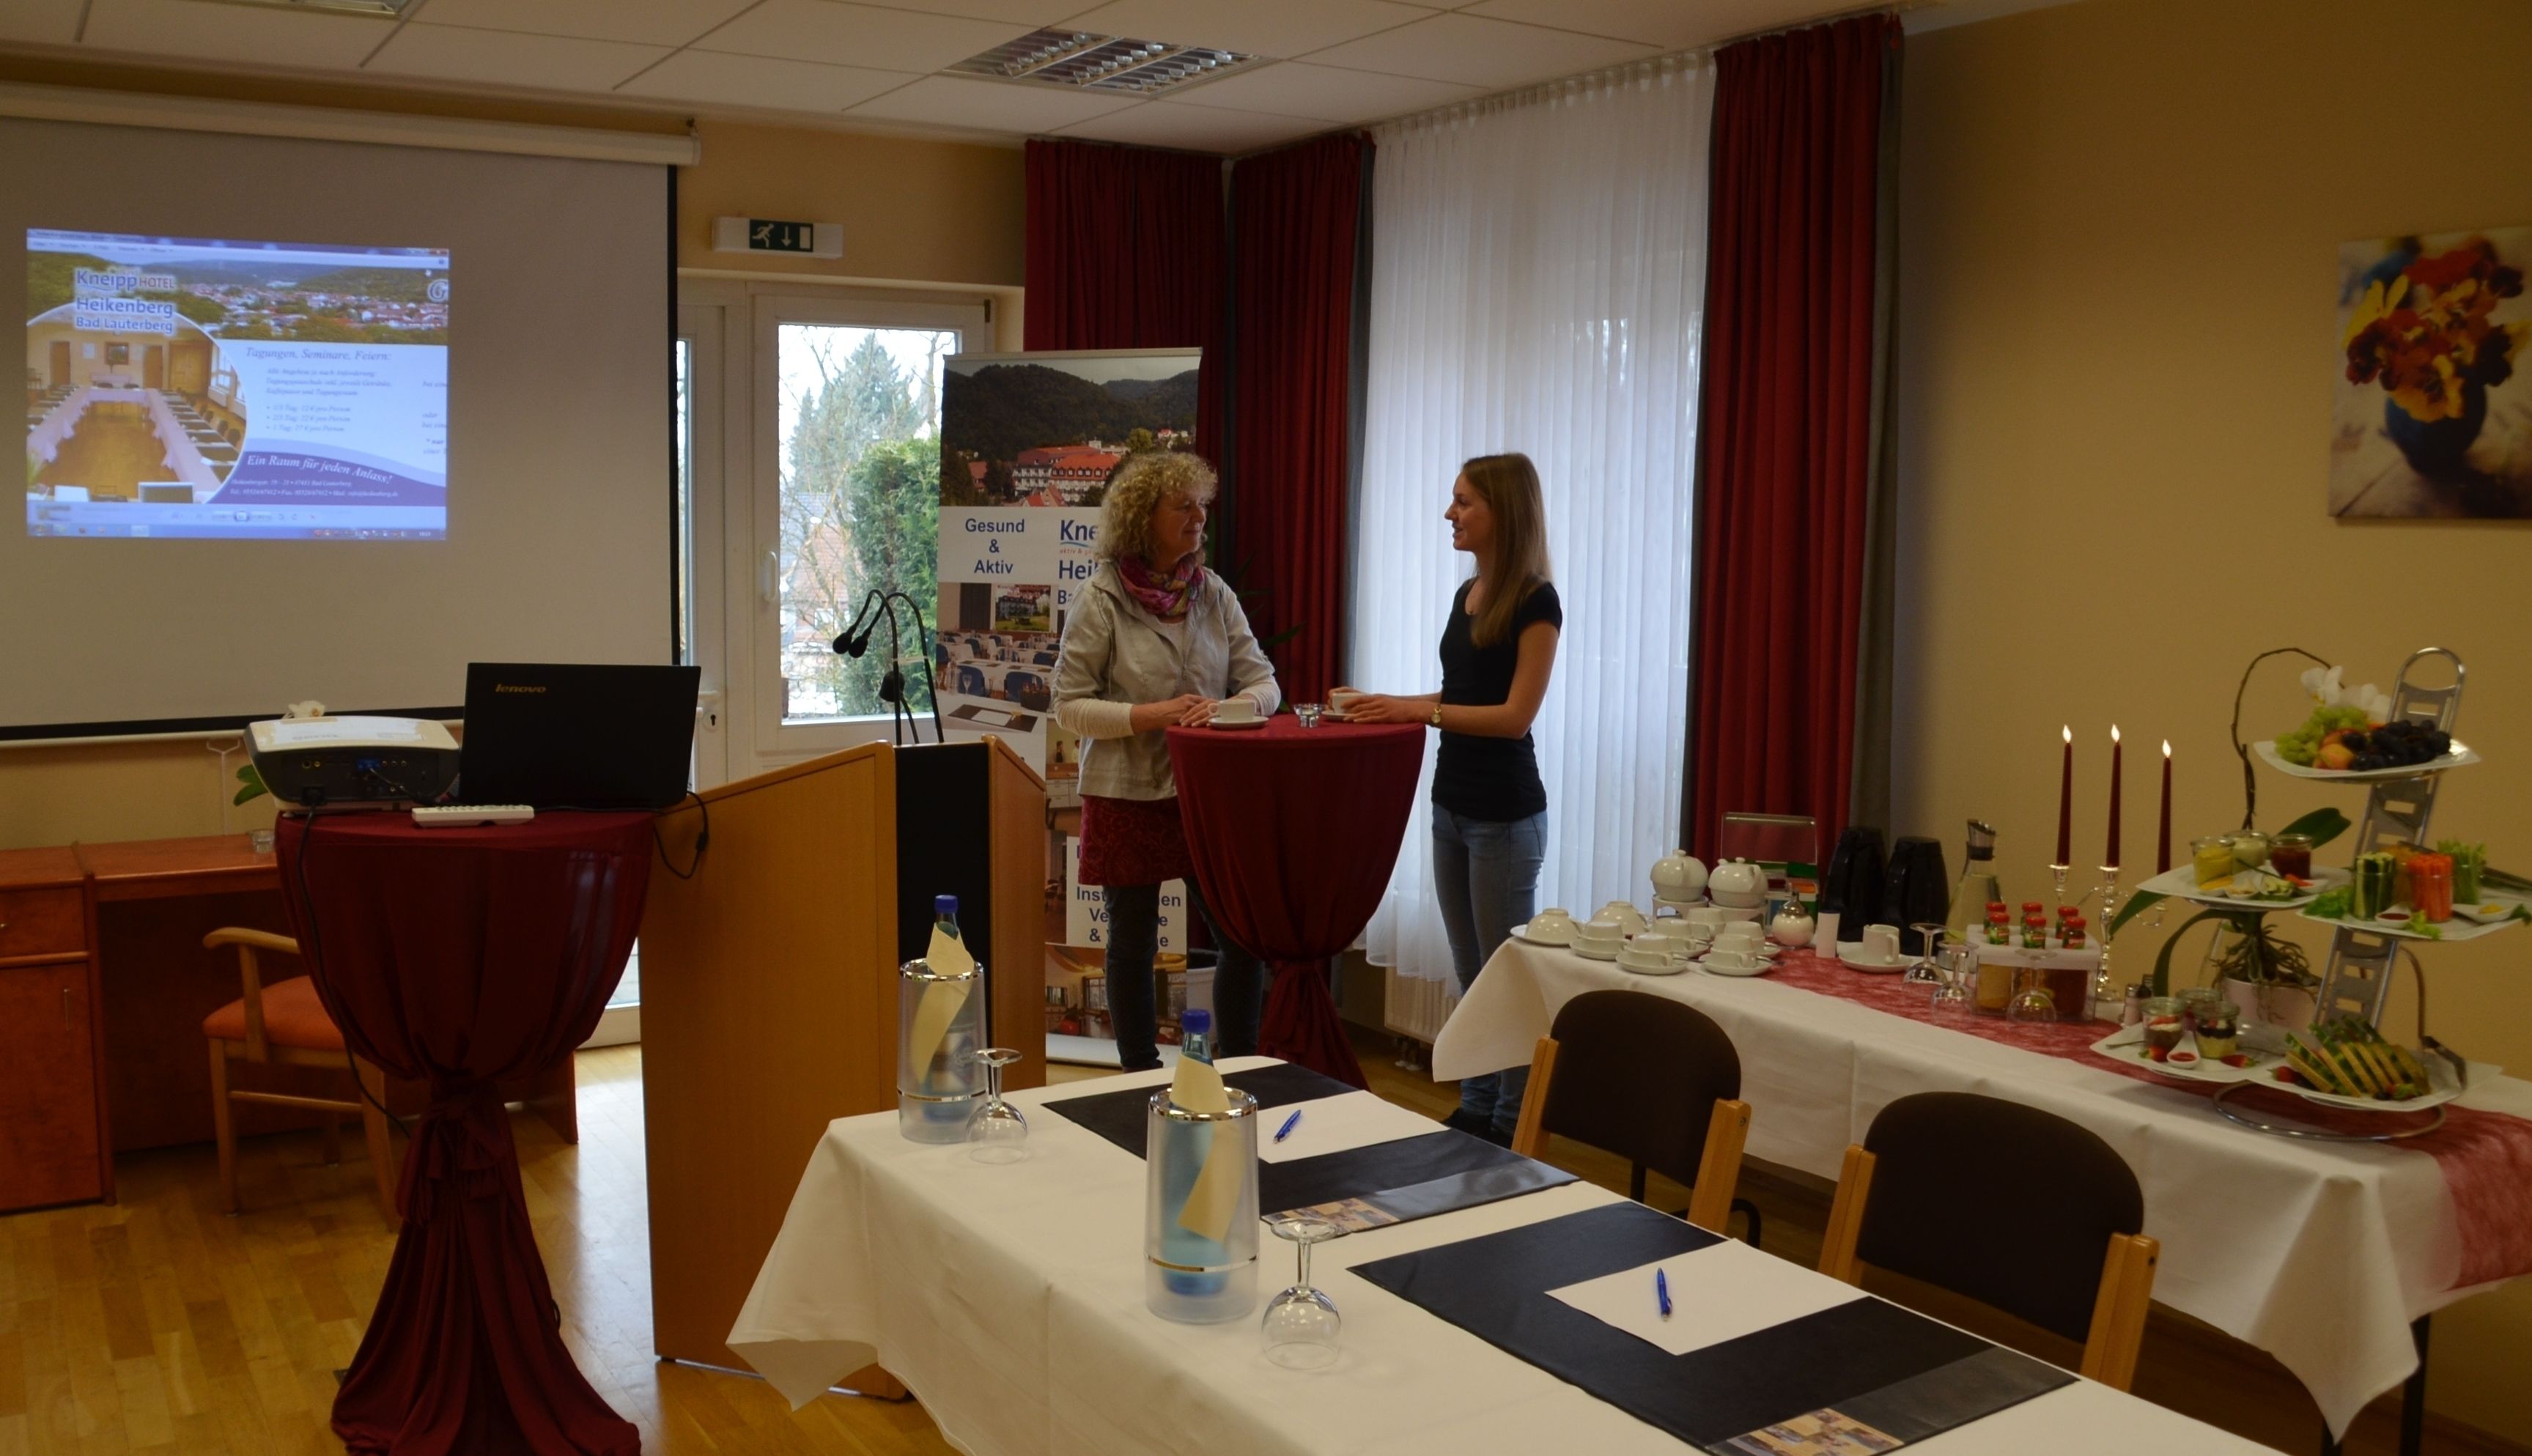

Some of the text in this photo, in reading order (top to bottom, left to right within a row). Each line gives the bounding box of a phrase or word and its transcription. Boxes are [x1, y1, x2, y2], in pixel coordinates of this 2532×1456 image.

[77, 270, 174, 290] Kneipp HOTEL
[76, 298, 173, 318] Heikenberg
[76, 317, 173, 334] Bad Lauterberg
[247, 455, 393, 484] Ein Raum für jeden Anlass!
[965, 517, 1025, 533] Gesund
[1060, 520, 1099, 541] Kne
[989, 539, 1000, 553] &
[974, 559, 1014, 574] Aktiv
[495, 683, 547, 693] lenovo
[1089, 928, 1101, 942] &
